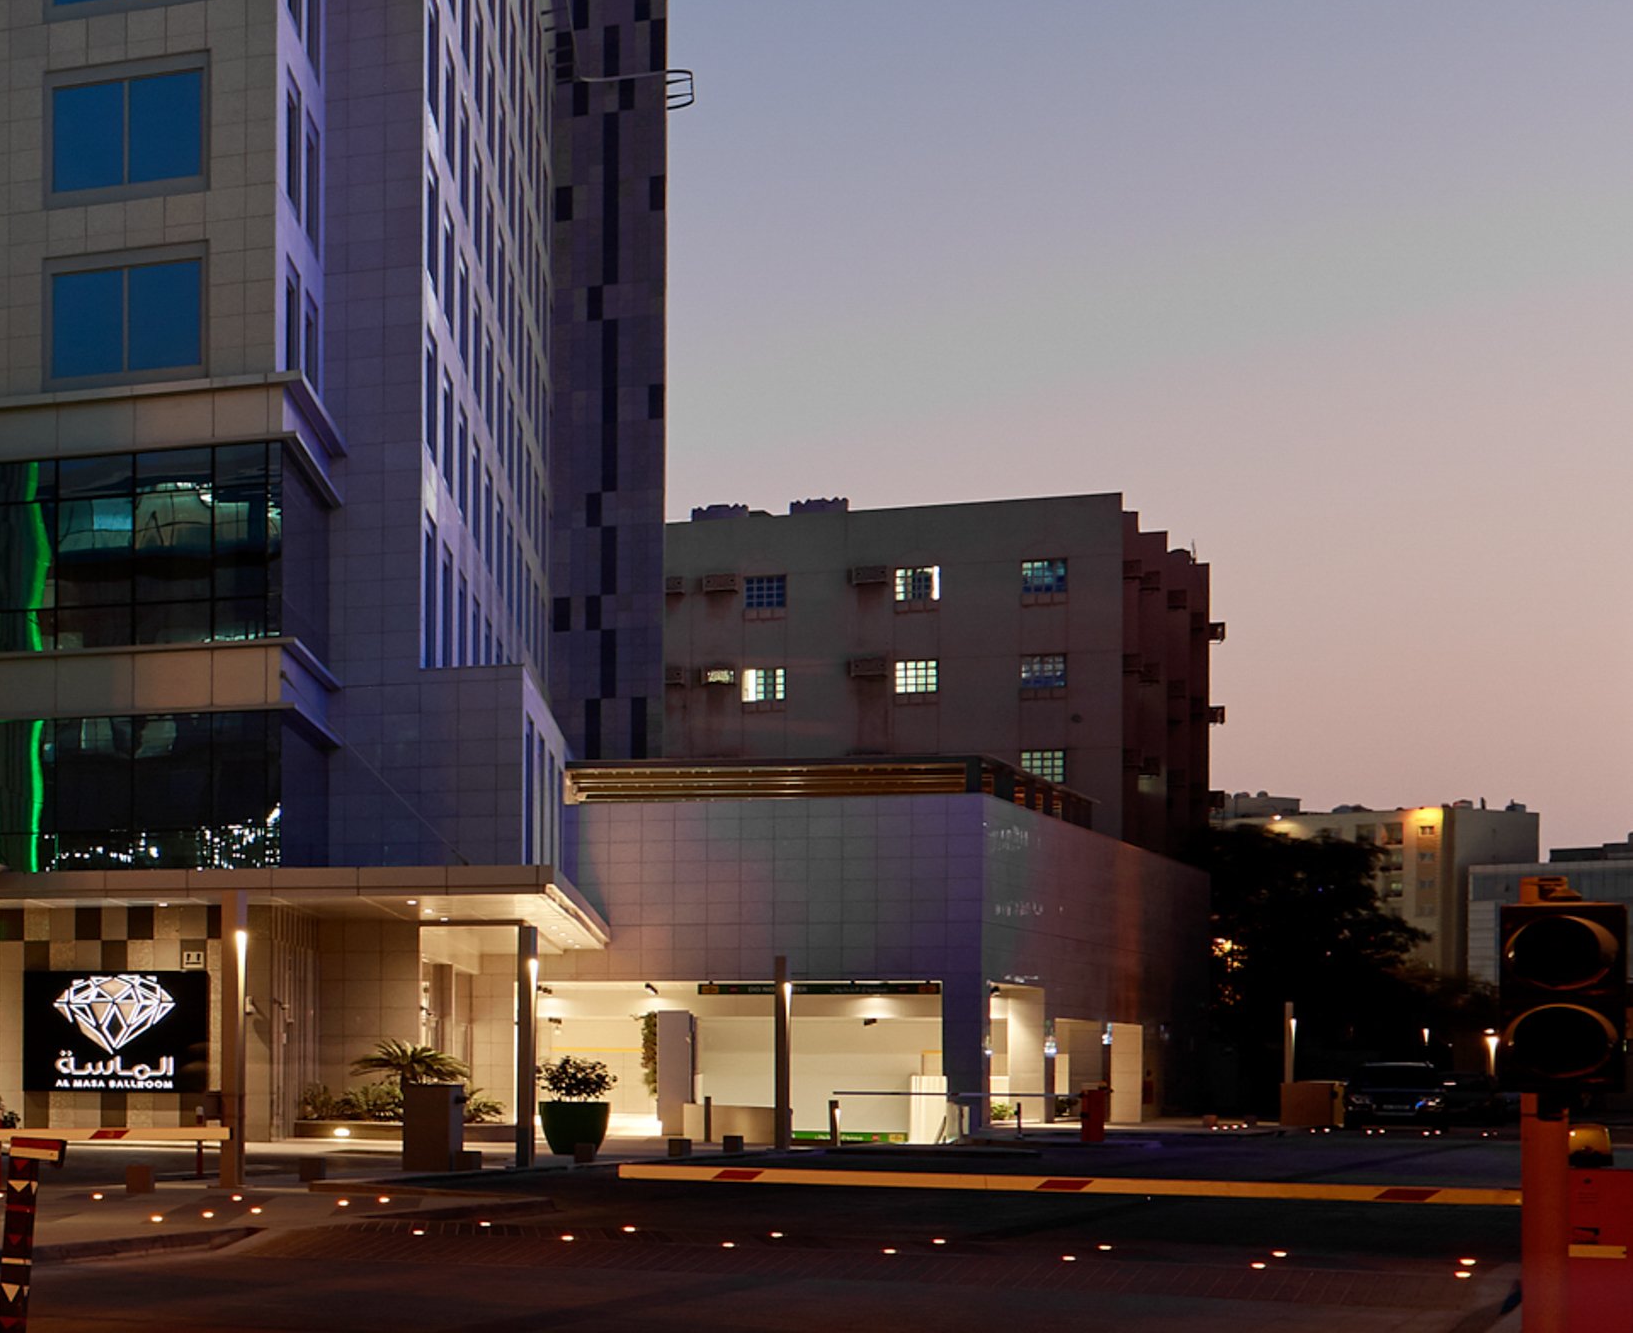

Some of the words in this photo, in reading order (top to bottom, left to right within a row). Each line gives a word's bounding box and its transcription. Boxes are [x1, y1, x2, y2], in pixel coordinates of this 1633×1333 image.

[54, 1079, 71, 1088] AL
[72, 1079, 105, 1088] MASA
[108, 1079, 174, 1089] BALLROOM
